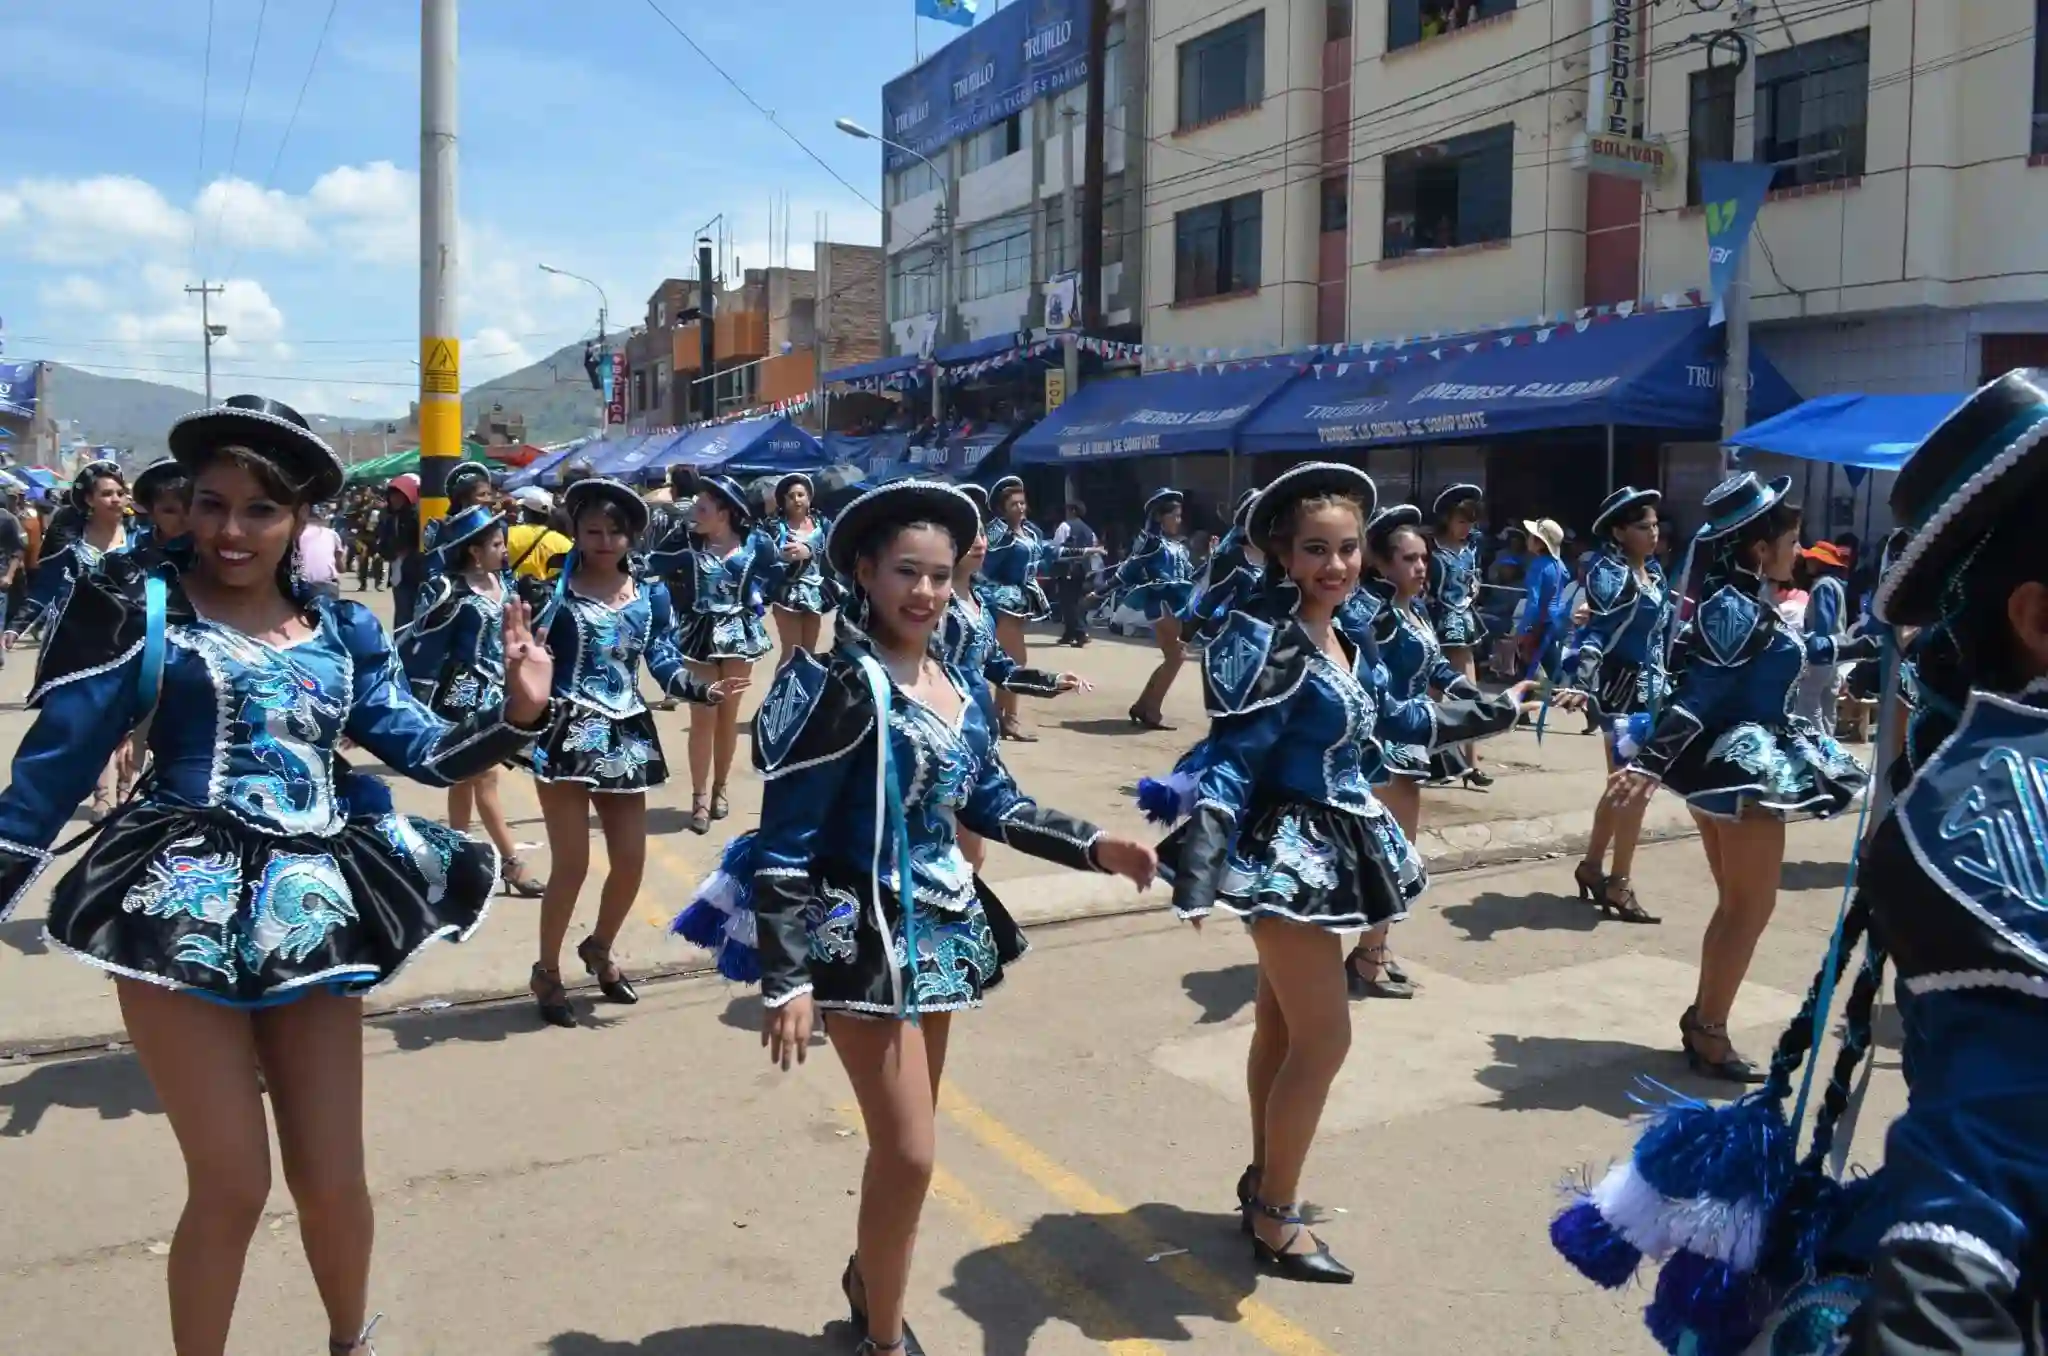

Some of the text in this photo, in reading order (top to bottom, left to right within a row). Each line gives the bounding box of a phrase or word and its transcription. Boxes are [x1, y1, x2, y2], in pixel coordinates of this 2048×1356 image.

[1023, 20, 1072, 61] TRUJILLO
[1593, 139, 1664, 165] BOLIVAR
[611, 364, 624, 422] BOTICA
[1407, 418, 1425, 435] SE
[1424, 411, 1488, 433] COMPARTE
